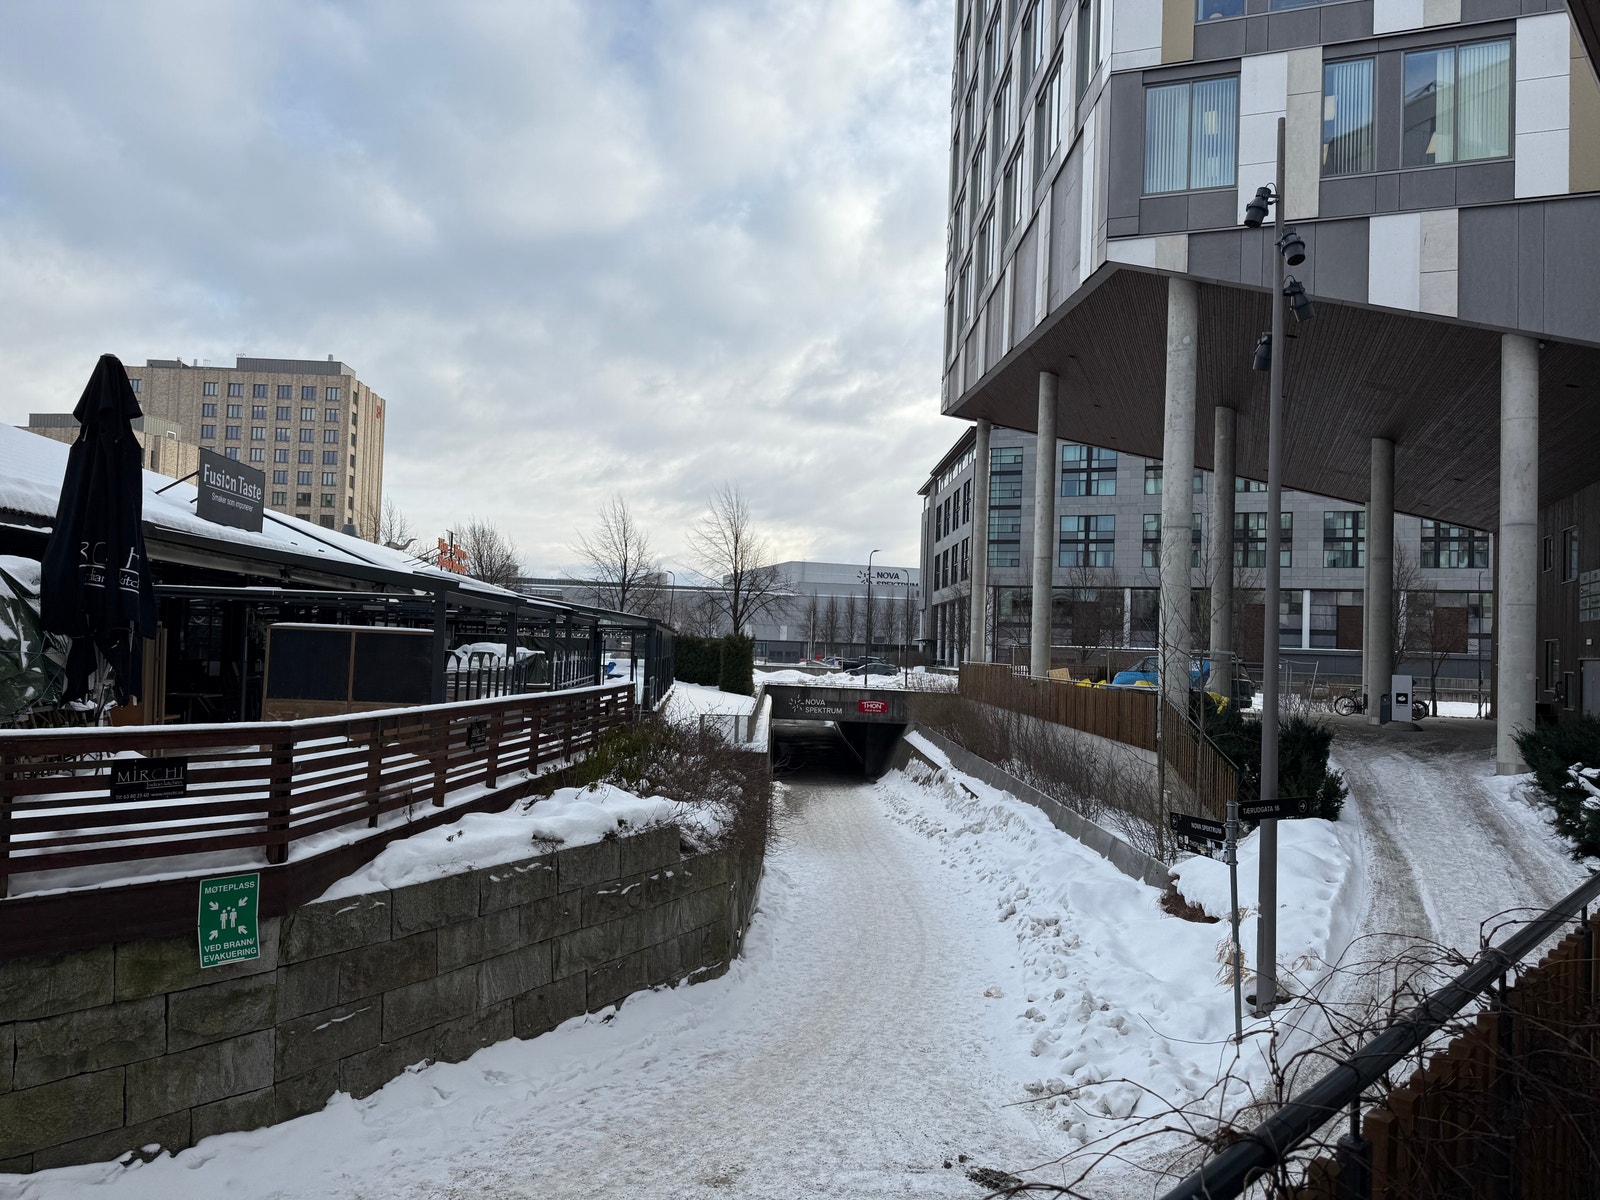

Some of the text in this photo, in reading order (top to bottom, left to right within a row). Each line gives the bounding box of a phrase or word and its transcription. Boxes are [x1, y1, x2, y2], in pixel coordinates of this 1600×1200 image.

[204, 463, 262, 500] Fusion Taste
[876, 571, 900, 580] NOVA
[862, 700, 884, 709] THON
[1190, 822, 1222, 834] NOVA SPEKTRUM
[205, 881, 255, 894] MØTEPLASS
[204, 938, 255, 952] VED BRANN/
[203, 947, 257, 963] EVAKUERING
